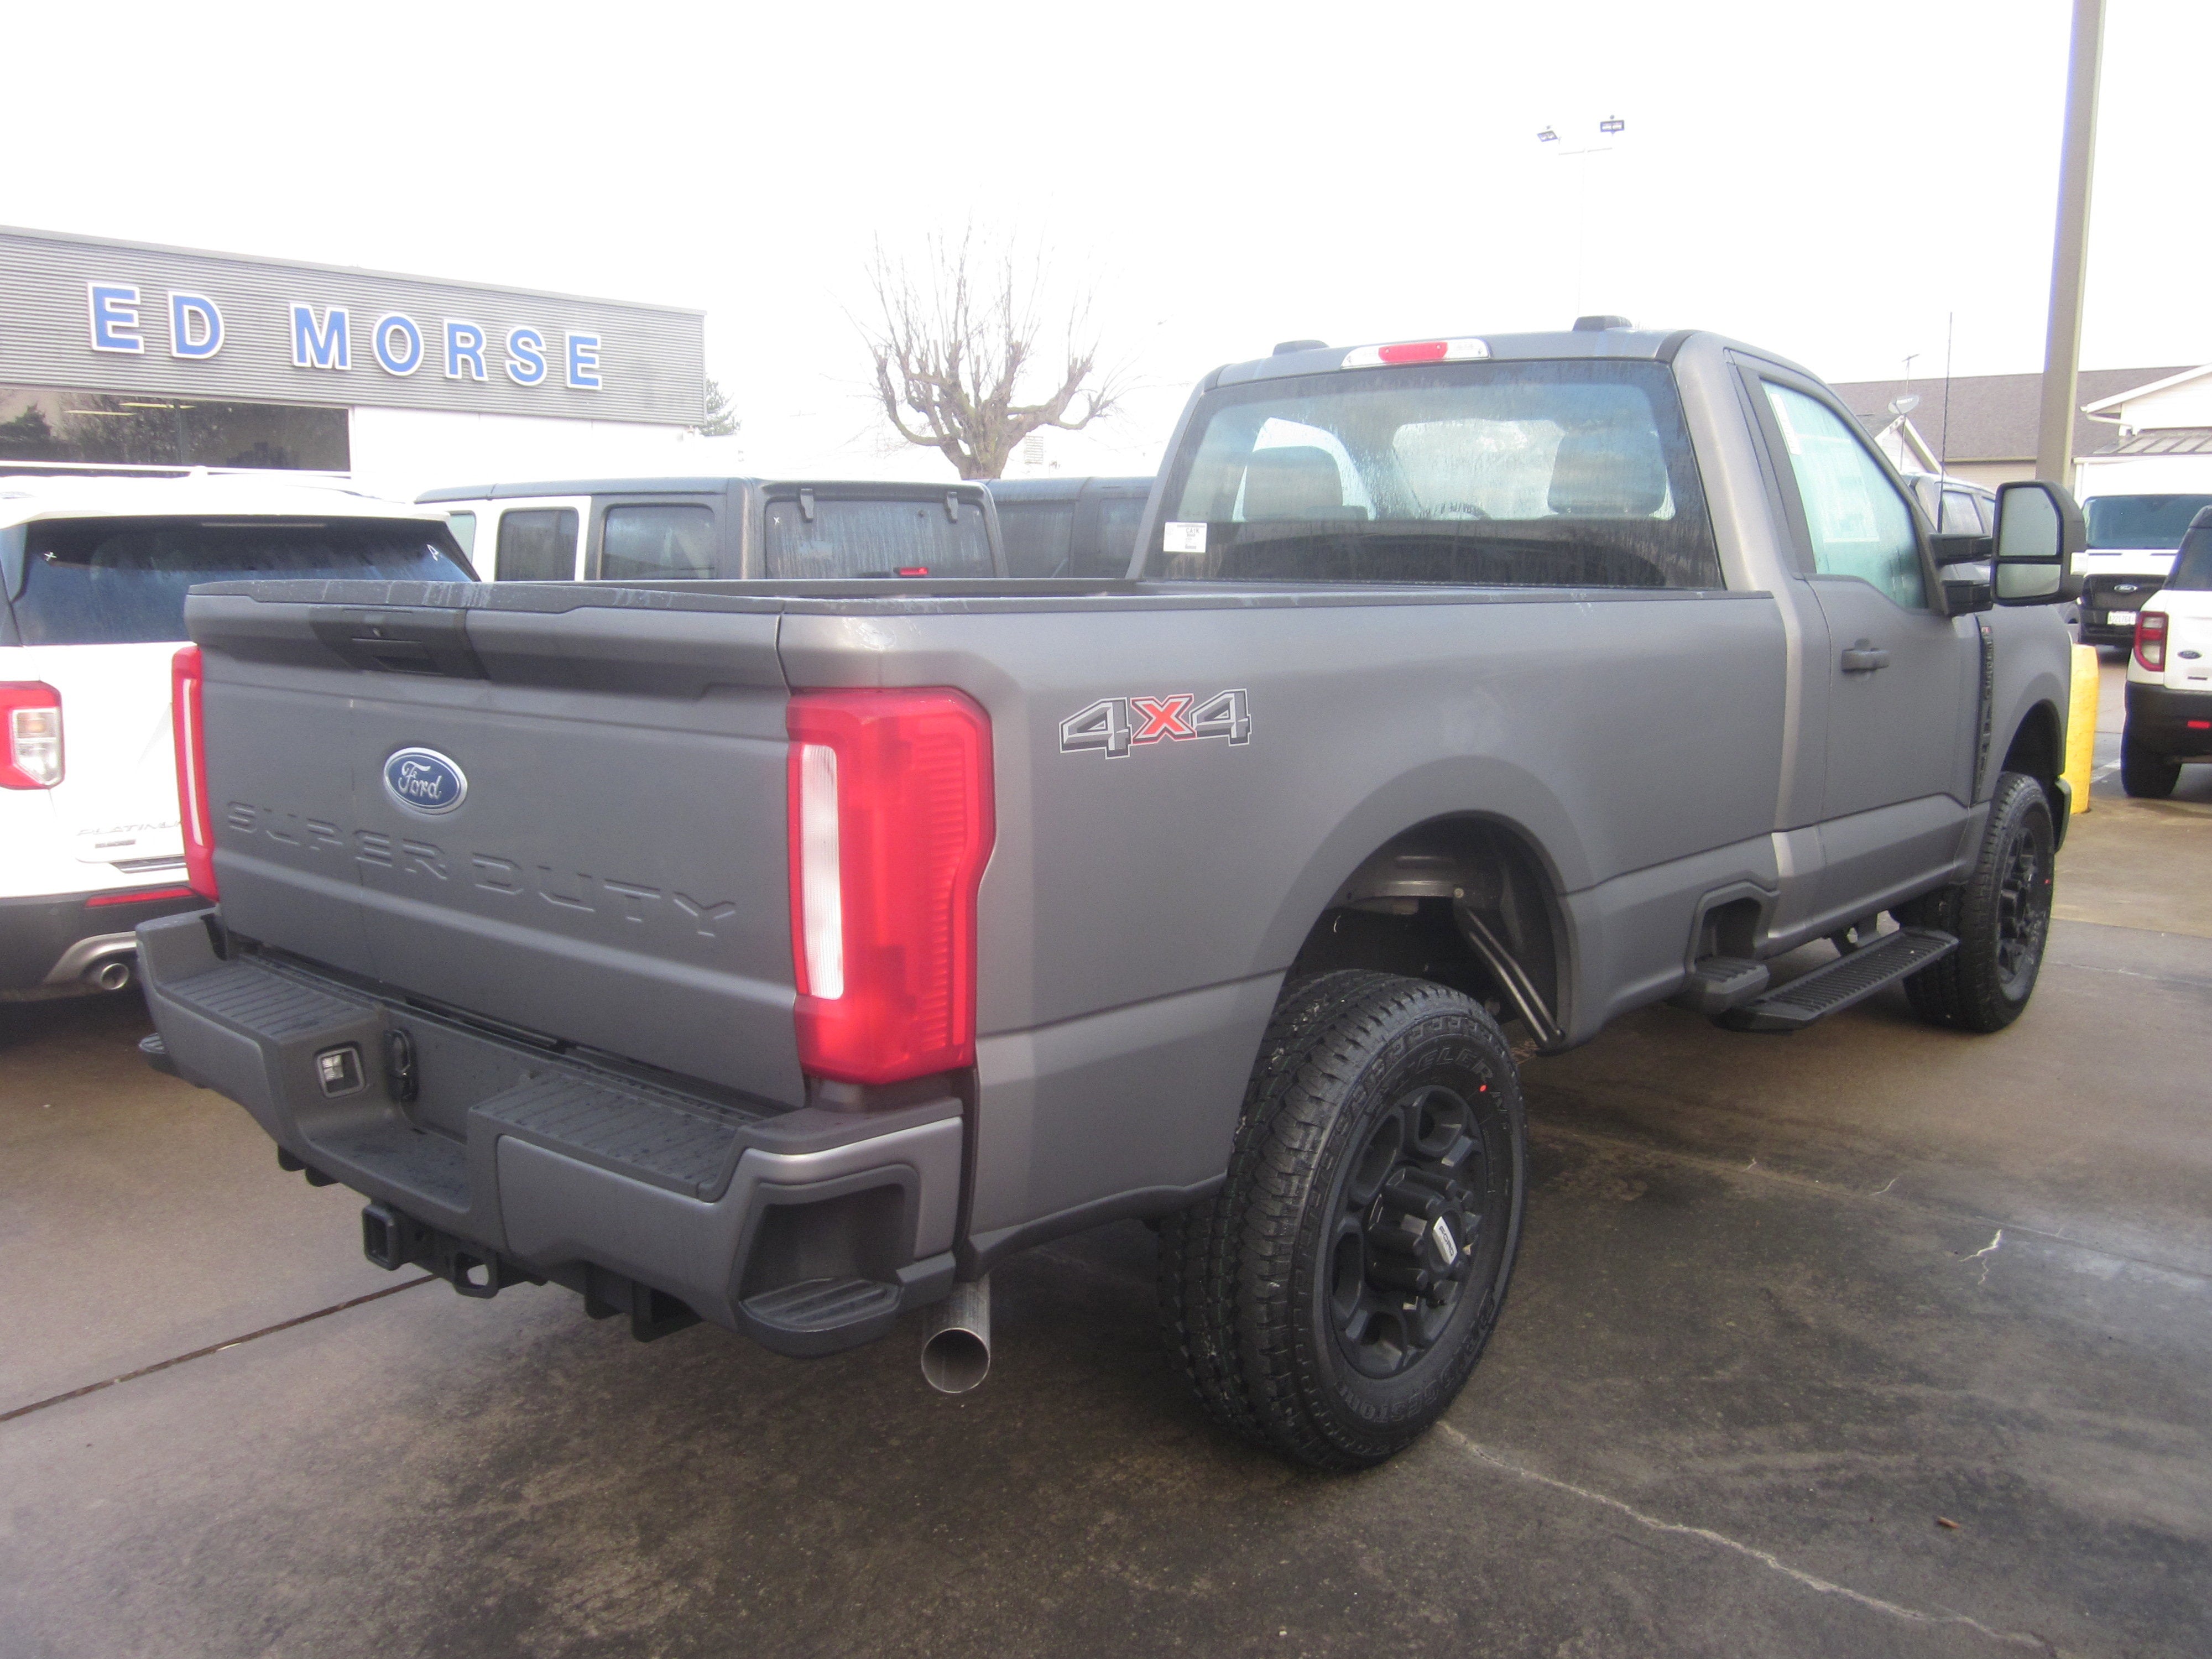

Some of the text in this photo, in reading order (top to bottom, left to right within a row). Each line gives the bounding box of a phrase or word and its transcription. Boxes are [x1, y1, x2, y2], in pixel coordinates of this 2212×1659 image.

[87, 281, 603, 390] ED MORSE
[398, 760, 444, 800] Ford
[227, 801, 736, 937] SUPER DUTY
[1439, 1225, 1454, 1256] FORD
